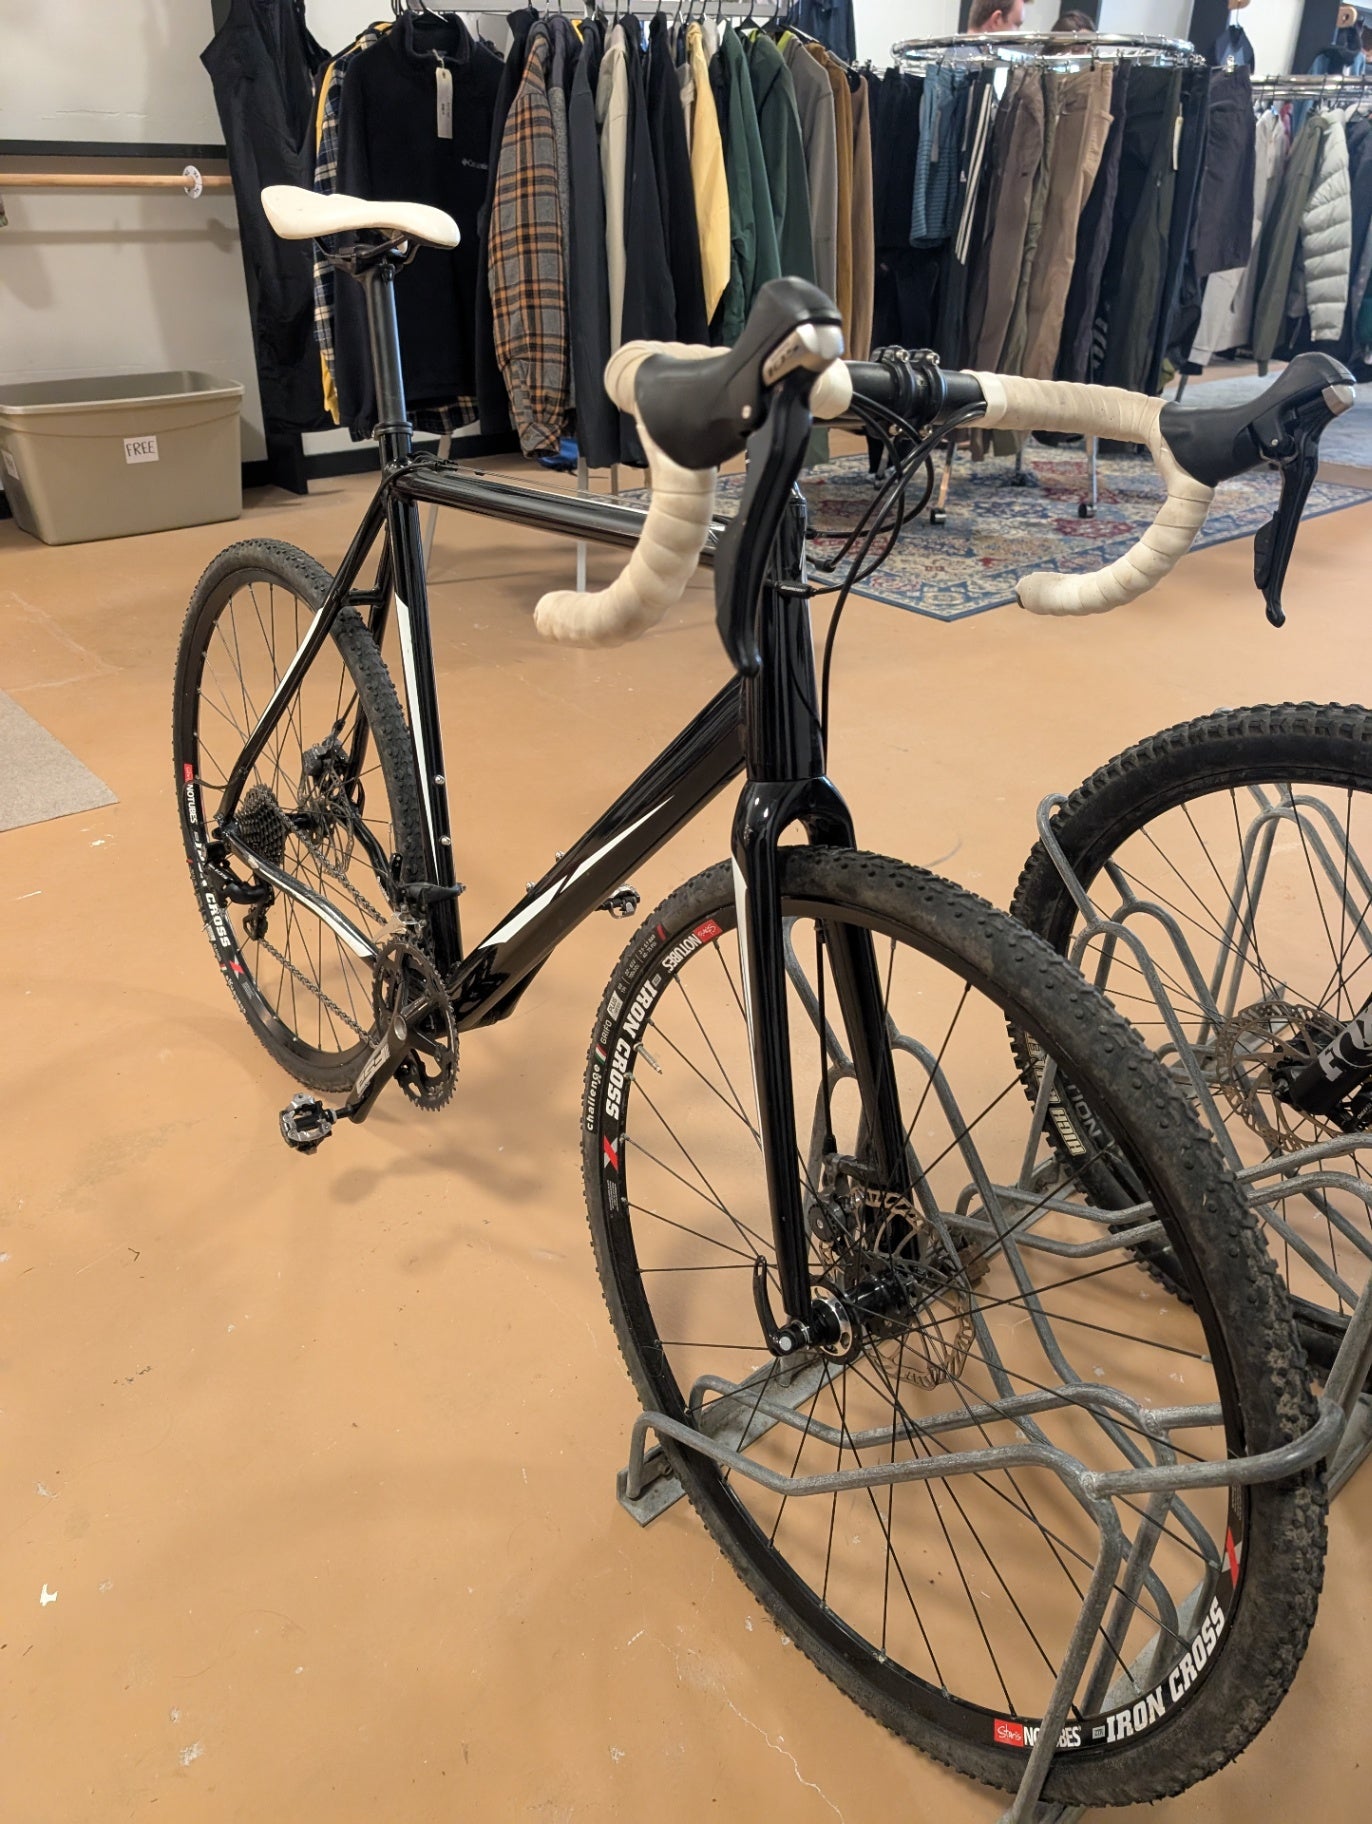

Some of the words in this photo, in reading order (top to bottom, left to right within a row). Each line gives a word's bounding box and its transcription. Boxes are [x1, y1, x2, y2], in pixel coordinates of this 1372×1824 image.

[126, 441, 156, 457] FREE
[187, 784, 197, 824] NOTUBES
[205, 892, 231, 948] CROSS
[662, 934, 702, 973] NOTUBES
[622, 979, 658, 1039] IRON
[586, 1064, 602, 1131] challenge
[605, 1038, 631, 1120] CROSS
[1051, 1108, 1086, 1154] HIGH
[1106, 1686, 1166, 1743] IRON
[1169, 1596, 1226, 1702] CROSS
[1023, 1726, 1082, 1748] NBES
